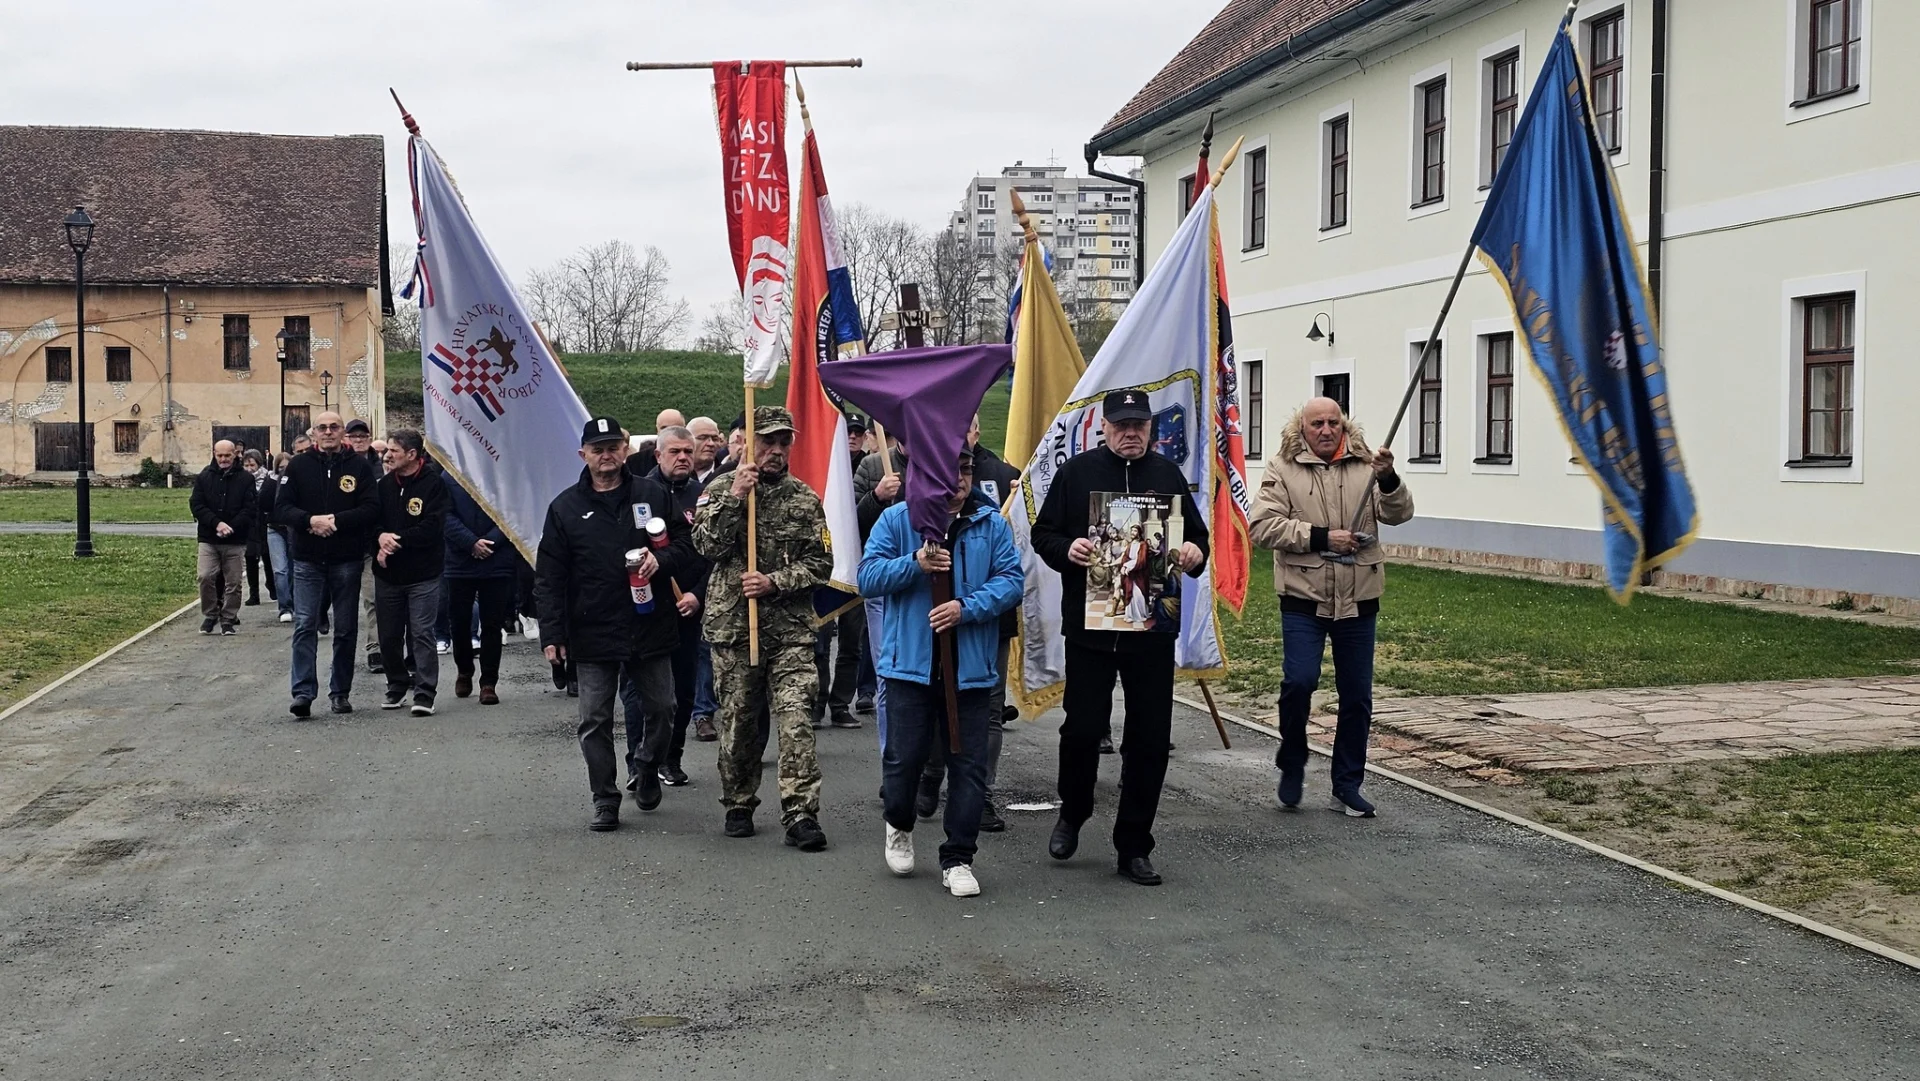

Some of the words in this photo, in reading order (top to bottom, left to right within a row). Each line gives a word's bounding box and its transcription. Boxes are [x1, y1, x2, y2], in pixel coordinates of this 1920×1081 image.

[452, 303, 504, 350] HRVATSKI
[498, 382, 536, 400] ZBOR
[461, 420, 501, 462] ŽUPANIJA
